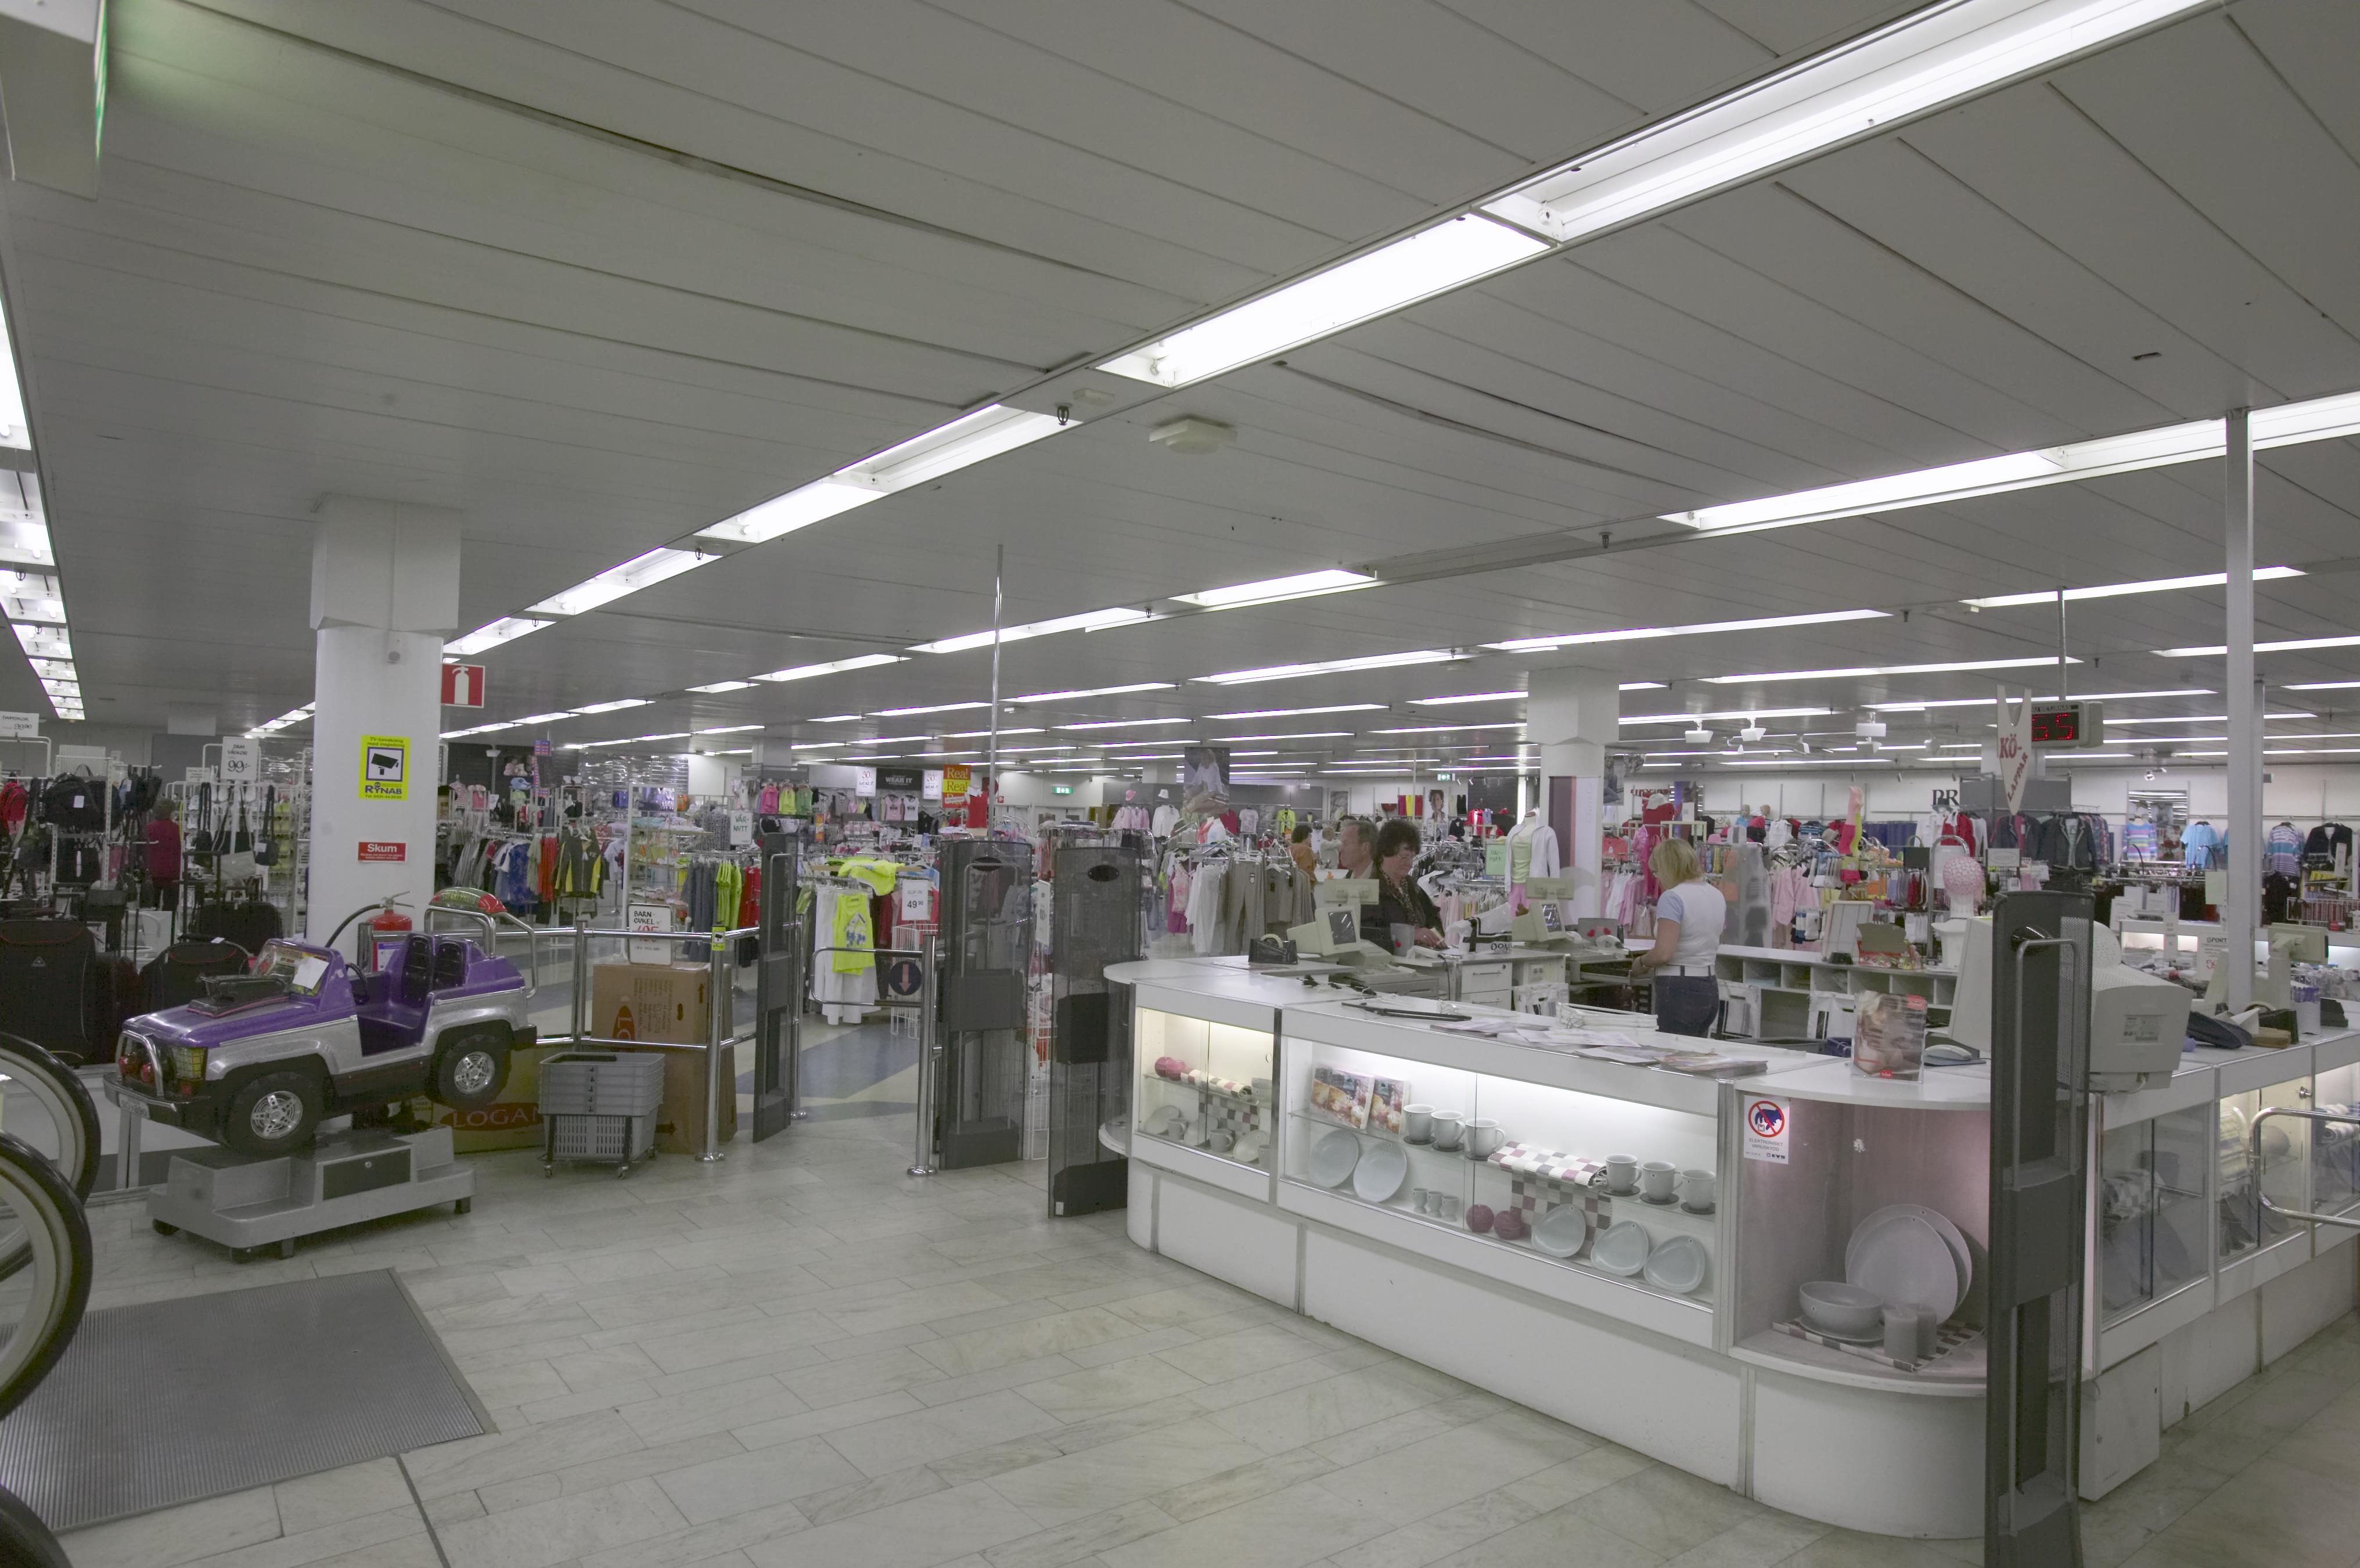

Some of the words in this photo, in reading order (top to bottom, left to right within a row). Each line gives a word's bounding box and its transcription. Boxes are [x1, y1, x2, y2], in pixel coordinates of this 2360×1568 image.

[1999, 733, 2023, 759] KÖ-
[365, 784, 402, 795] RYNAB
[367, 843, 397, 853] Skum
[906, 900, 918, 909] 49
[1749, 1138, 1783, 1147] ELEKTRONISKT
[1751, 1143, 1780, 1152] VARUSKYDD
